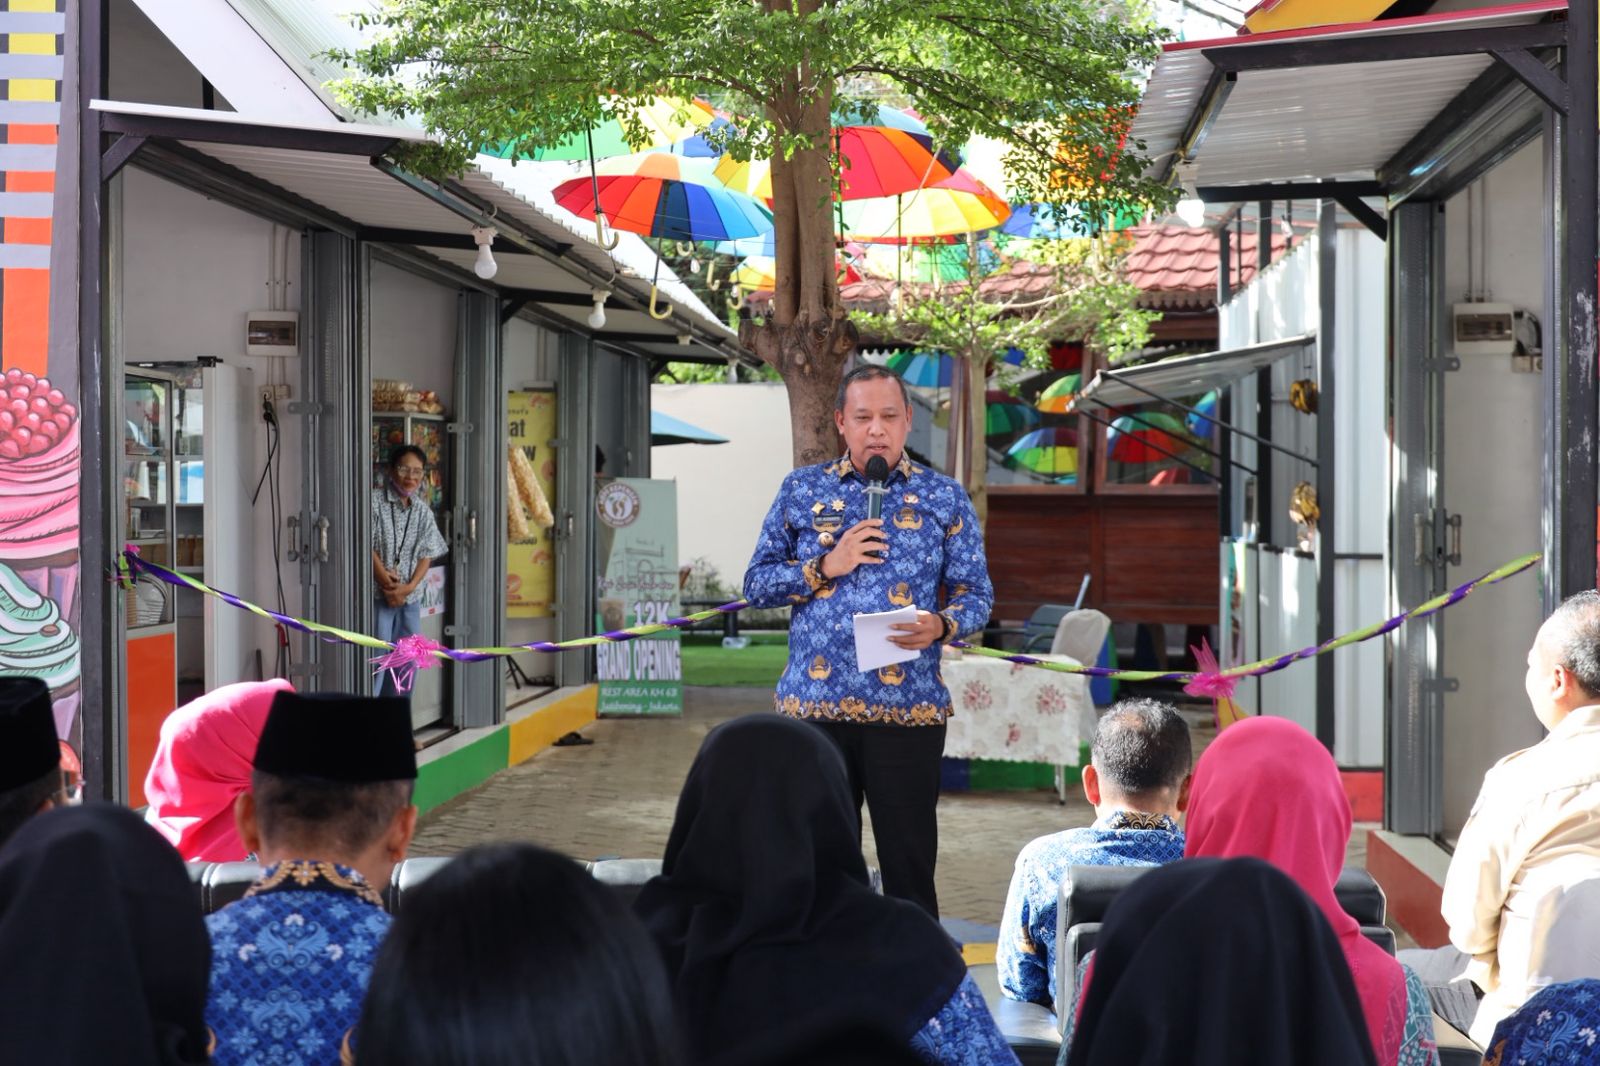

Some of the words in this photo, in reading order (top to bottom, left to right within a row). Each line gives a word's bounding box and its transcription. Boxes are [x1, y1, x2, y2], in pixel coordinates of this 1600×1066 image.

[634, 601, 670, 627] 12K
[597, 640, 631, 681] GRAND
[633, 639, 681, 681] OPENING
[602, 687, 621, 697] REST
[622, 687, 648, 697] AREA
